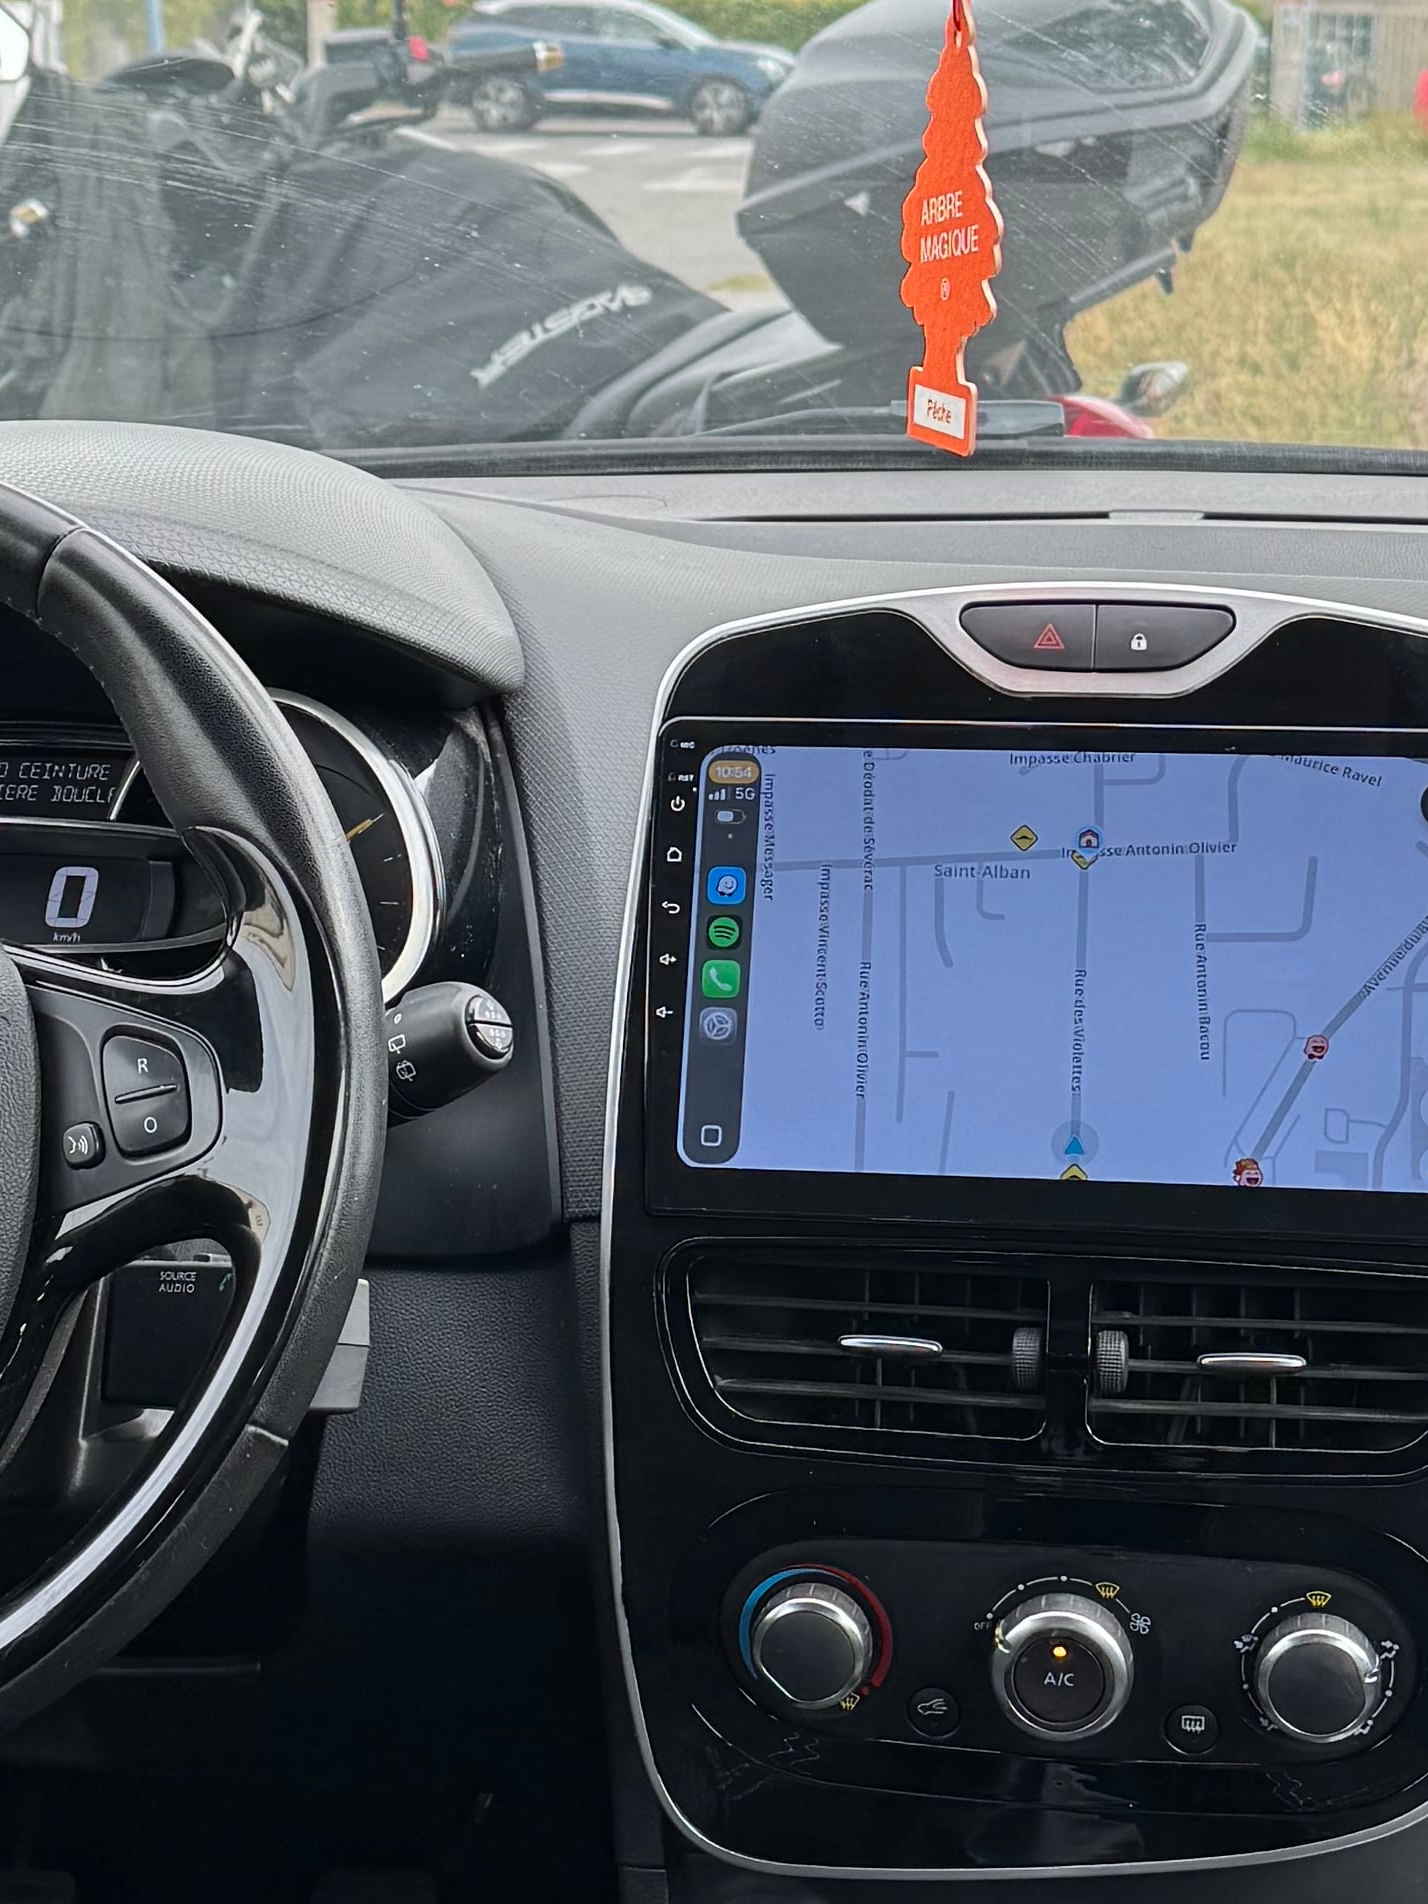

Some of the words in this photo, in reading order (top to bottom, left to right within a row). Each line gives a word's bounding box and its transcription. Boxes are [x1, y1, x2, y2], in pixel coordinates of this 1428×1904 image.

[921, 190, 963, 226] ARBRE
[920, 224, 979, 264] MAGIQUE
[1009, 752, 1069, 767] Impasse
[1073, 751, 1136, 764] Chabrier
[19, 762, 111, 780] CEINTURE
[1342, 766, 1383, 787] Ravel
[735, 787, 755, 800] 5G
[1061, 845, 1122, 858] Imsse
[1125, 844, 1185, 856] Antonin
[1189, 842, 1237, 855] Olivier
[934, 864, 1031, 879] Saint-Alban
[45, 866, 99, 928] 0
[1195, 923, 1207, 951] Rue
[859, 961, 872, 989] Rue
[1074, 969, 1087, 996] Rue
[1196, 955, 1209, 1012] Antonin
[857, 992, 870, 1048] Antonin
[137, 1057, 149, 1074] R
[855, 1053, 869, 1099] Olivier
[160, 1271, 196, 1281] SOURCE
[159, 1284, 195, 1294] AUDIO
[1044, 1672, 1075, 1687] A/C
